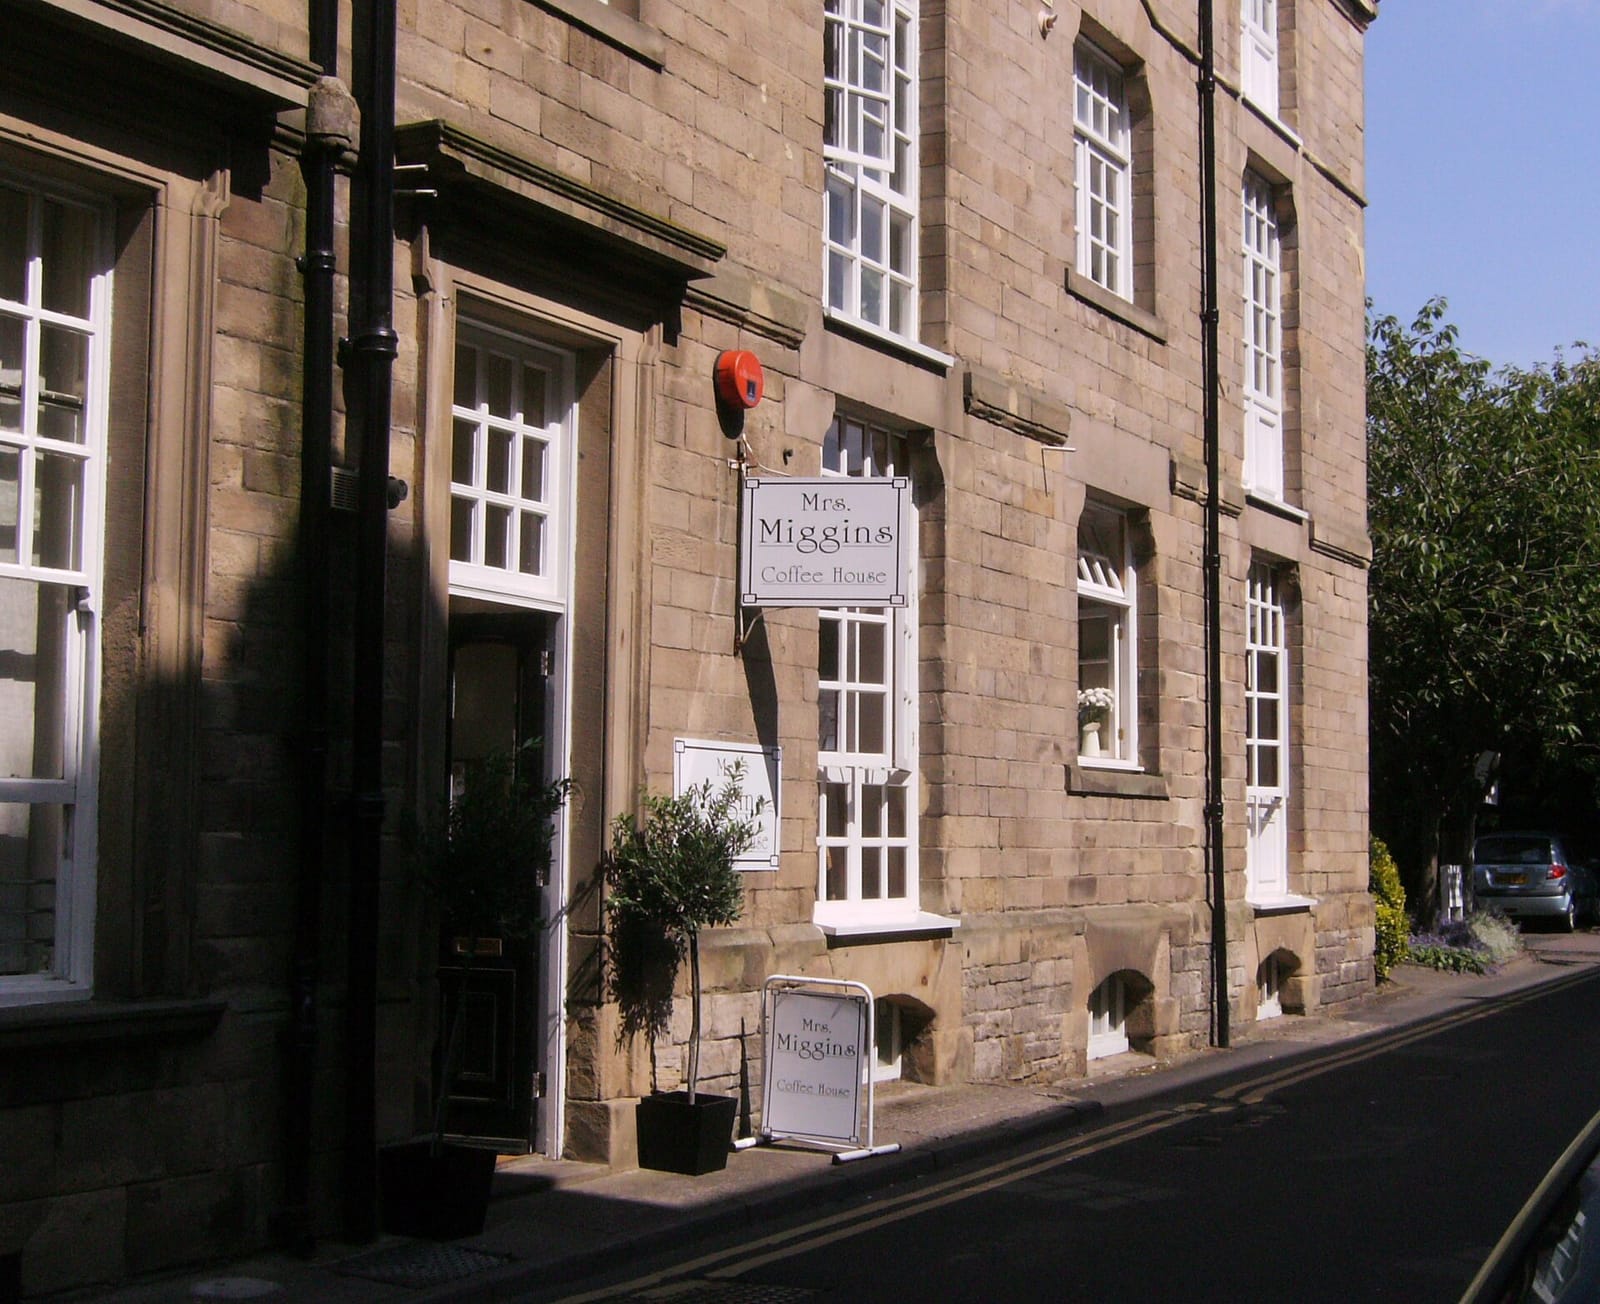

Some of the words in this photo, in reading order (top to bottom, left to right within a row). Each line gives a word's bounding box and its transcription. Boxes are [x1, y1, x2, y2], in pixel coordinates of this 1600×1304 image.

[802, 493, 851, 511] Mrs.
[759, 518, 893, 554] Miggins
[761, 565, 823, 583] Coffee
[833, 567, 887, 584] House
[802, 1018, 832, 1033] Mrs.
[777, 1033, 856, 1061] Miggins
[776, 1079, 813, 1094] Coffee
[818, 1083, 850, 1097] House
